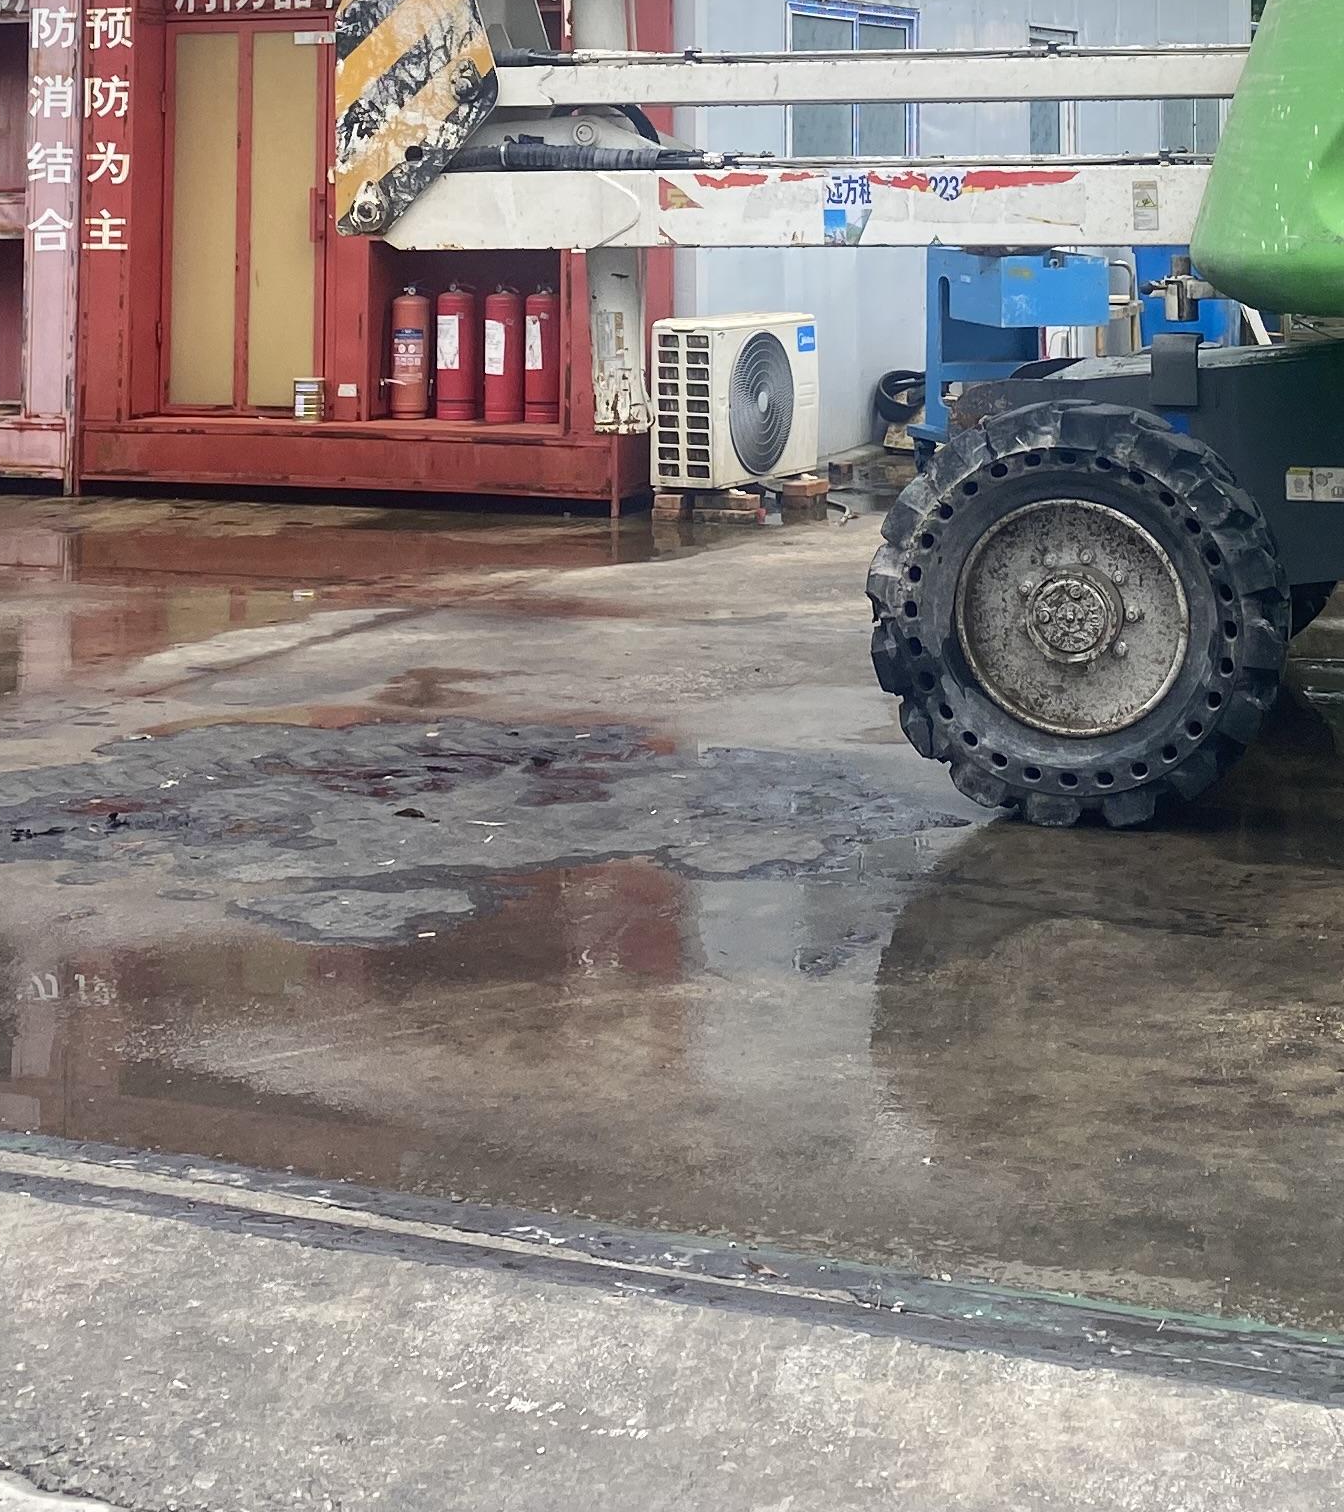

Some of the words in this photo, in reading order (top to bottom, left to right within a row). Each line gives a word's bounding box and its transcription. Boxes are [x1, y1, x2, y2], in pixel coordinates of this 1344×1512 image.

[27, 6, 77, 253] 防消结合
[82, 6, 135, 252] 预防为主
